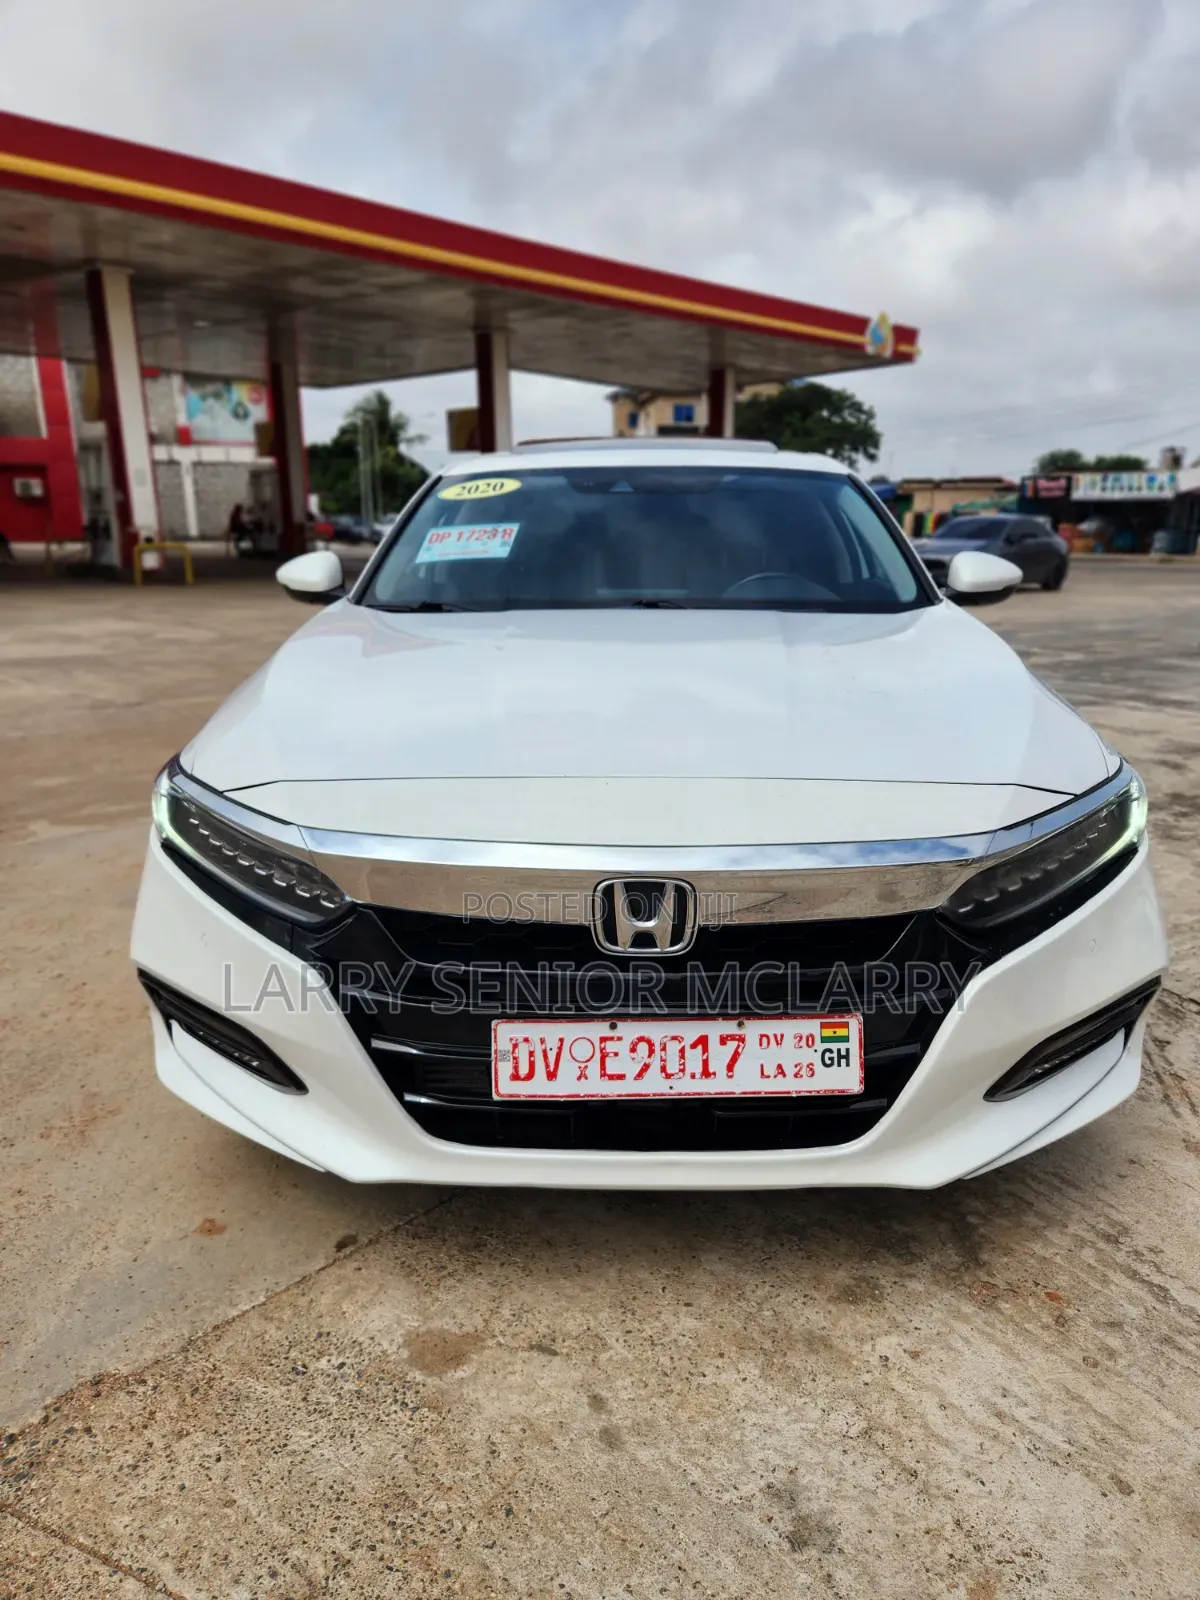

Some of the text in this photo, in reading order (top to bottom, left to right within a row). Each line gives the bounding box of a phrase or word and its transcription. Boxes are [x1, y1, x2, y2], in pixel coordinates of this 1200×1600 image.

[454, 481, 505, 497] 2020
[758, 1032, 816, 1049] DV 20
[509, 1034, 746, 1081] DV E9017
[820, 1047, 851, 1068] GH
[760, 1063, 787, 1079] LA
